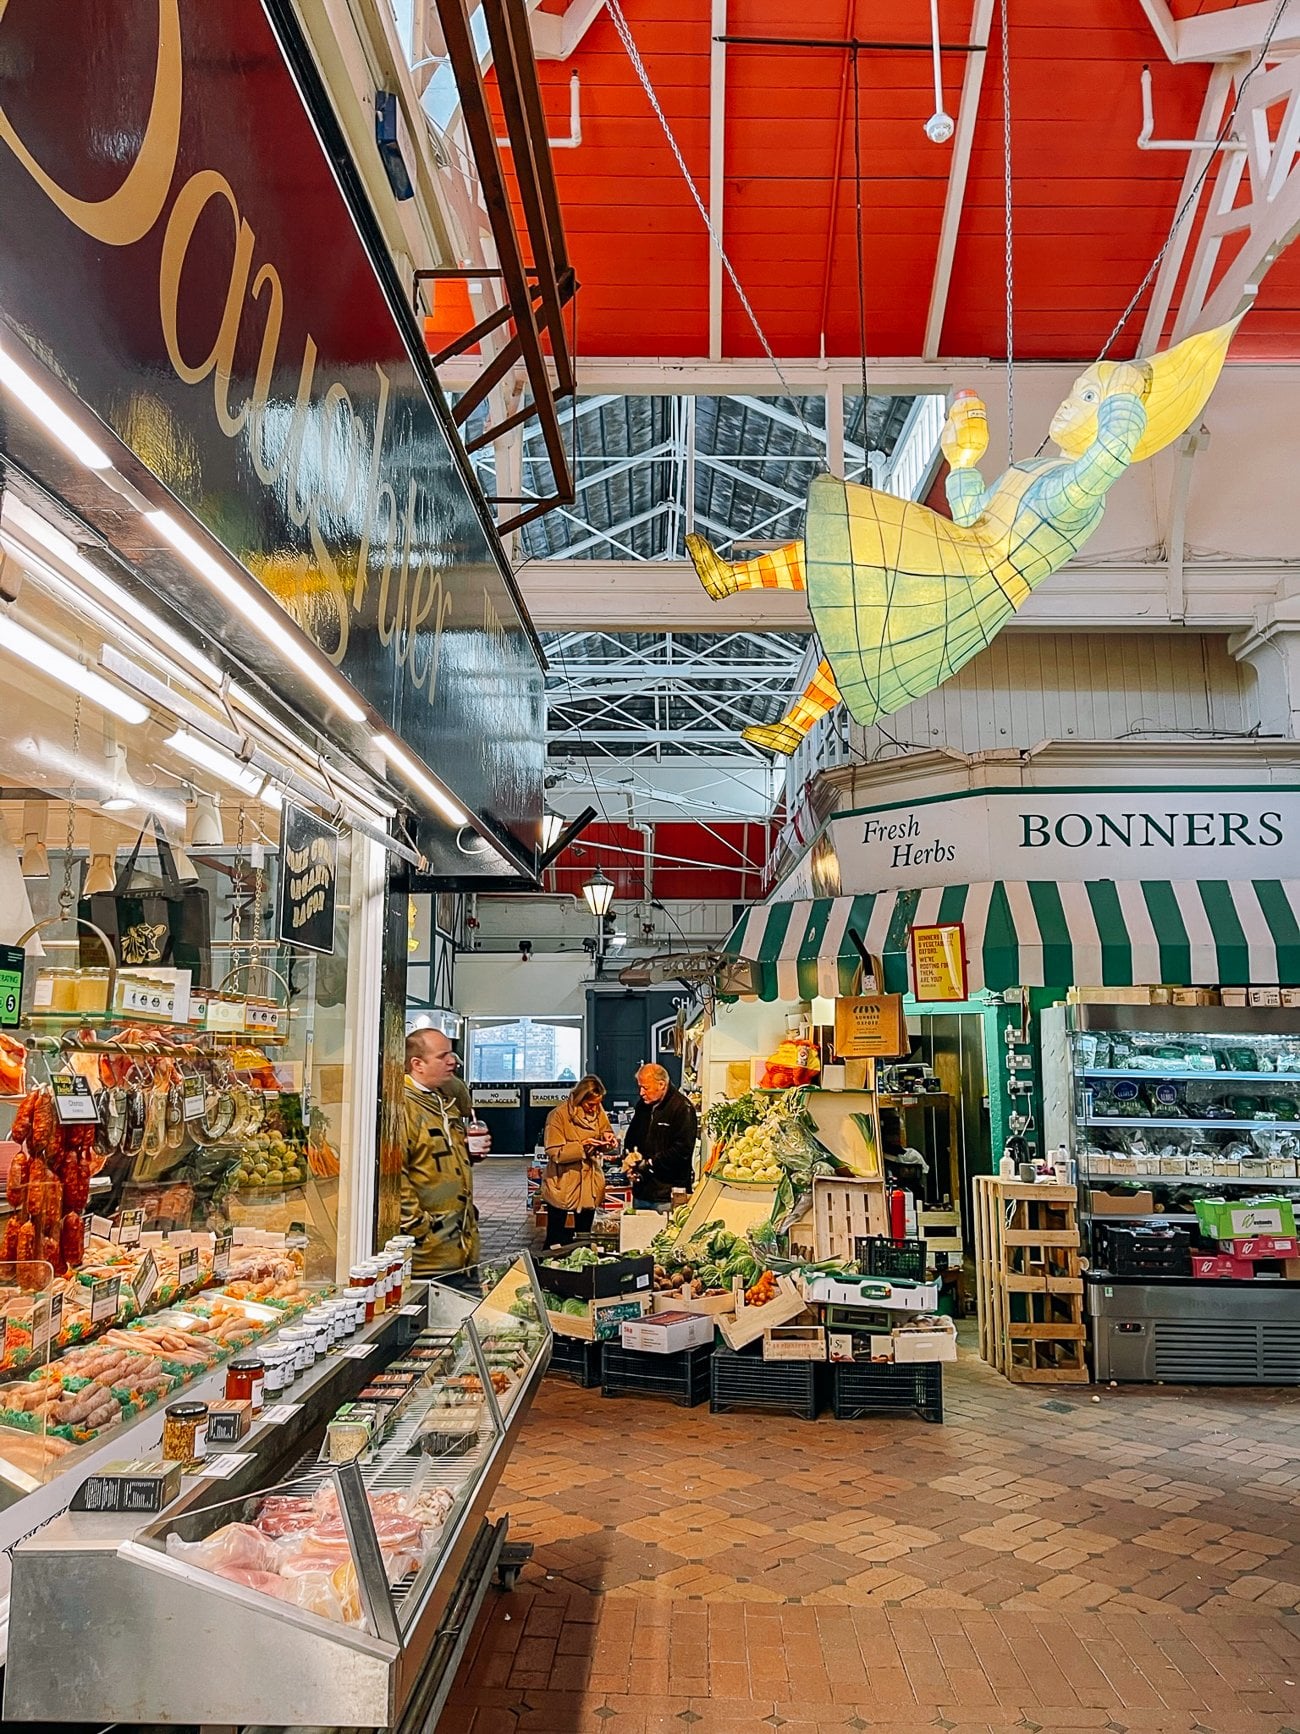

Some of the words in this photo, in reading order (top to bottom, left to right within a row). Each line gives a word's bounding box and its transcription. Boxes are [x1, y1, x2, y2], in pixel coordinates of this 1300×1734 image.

[861, 814, 921, 845] Fresh
[1018, 811, 1284, 848] BONNERS
[890, 839, 956, 868] Herbs
[7, 996, 14, 1011] 5
